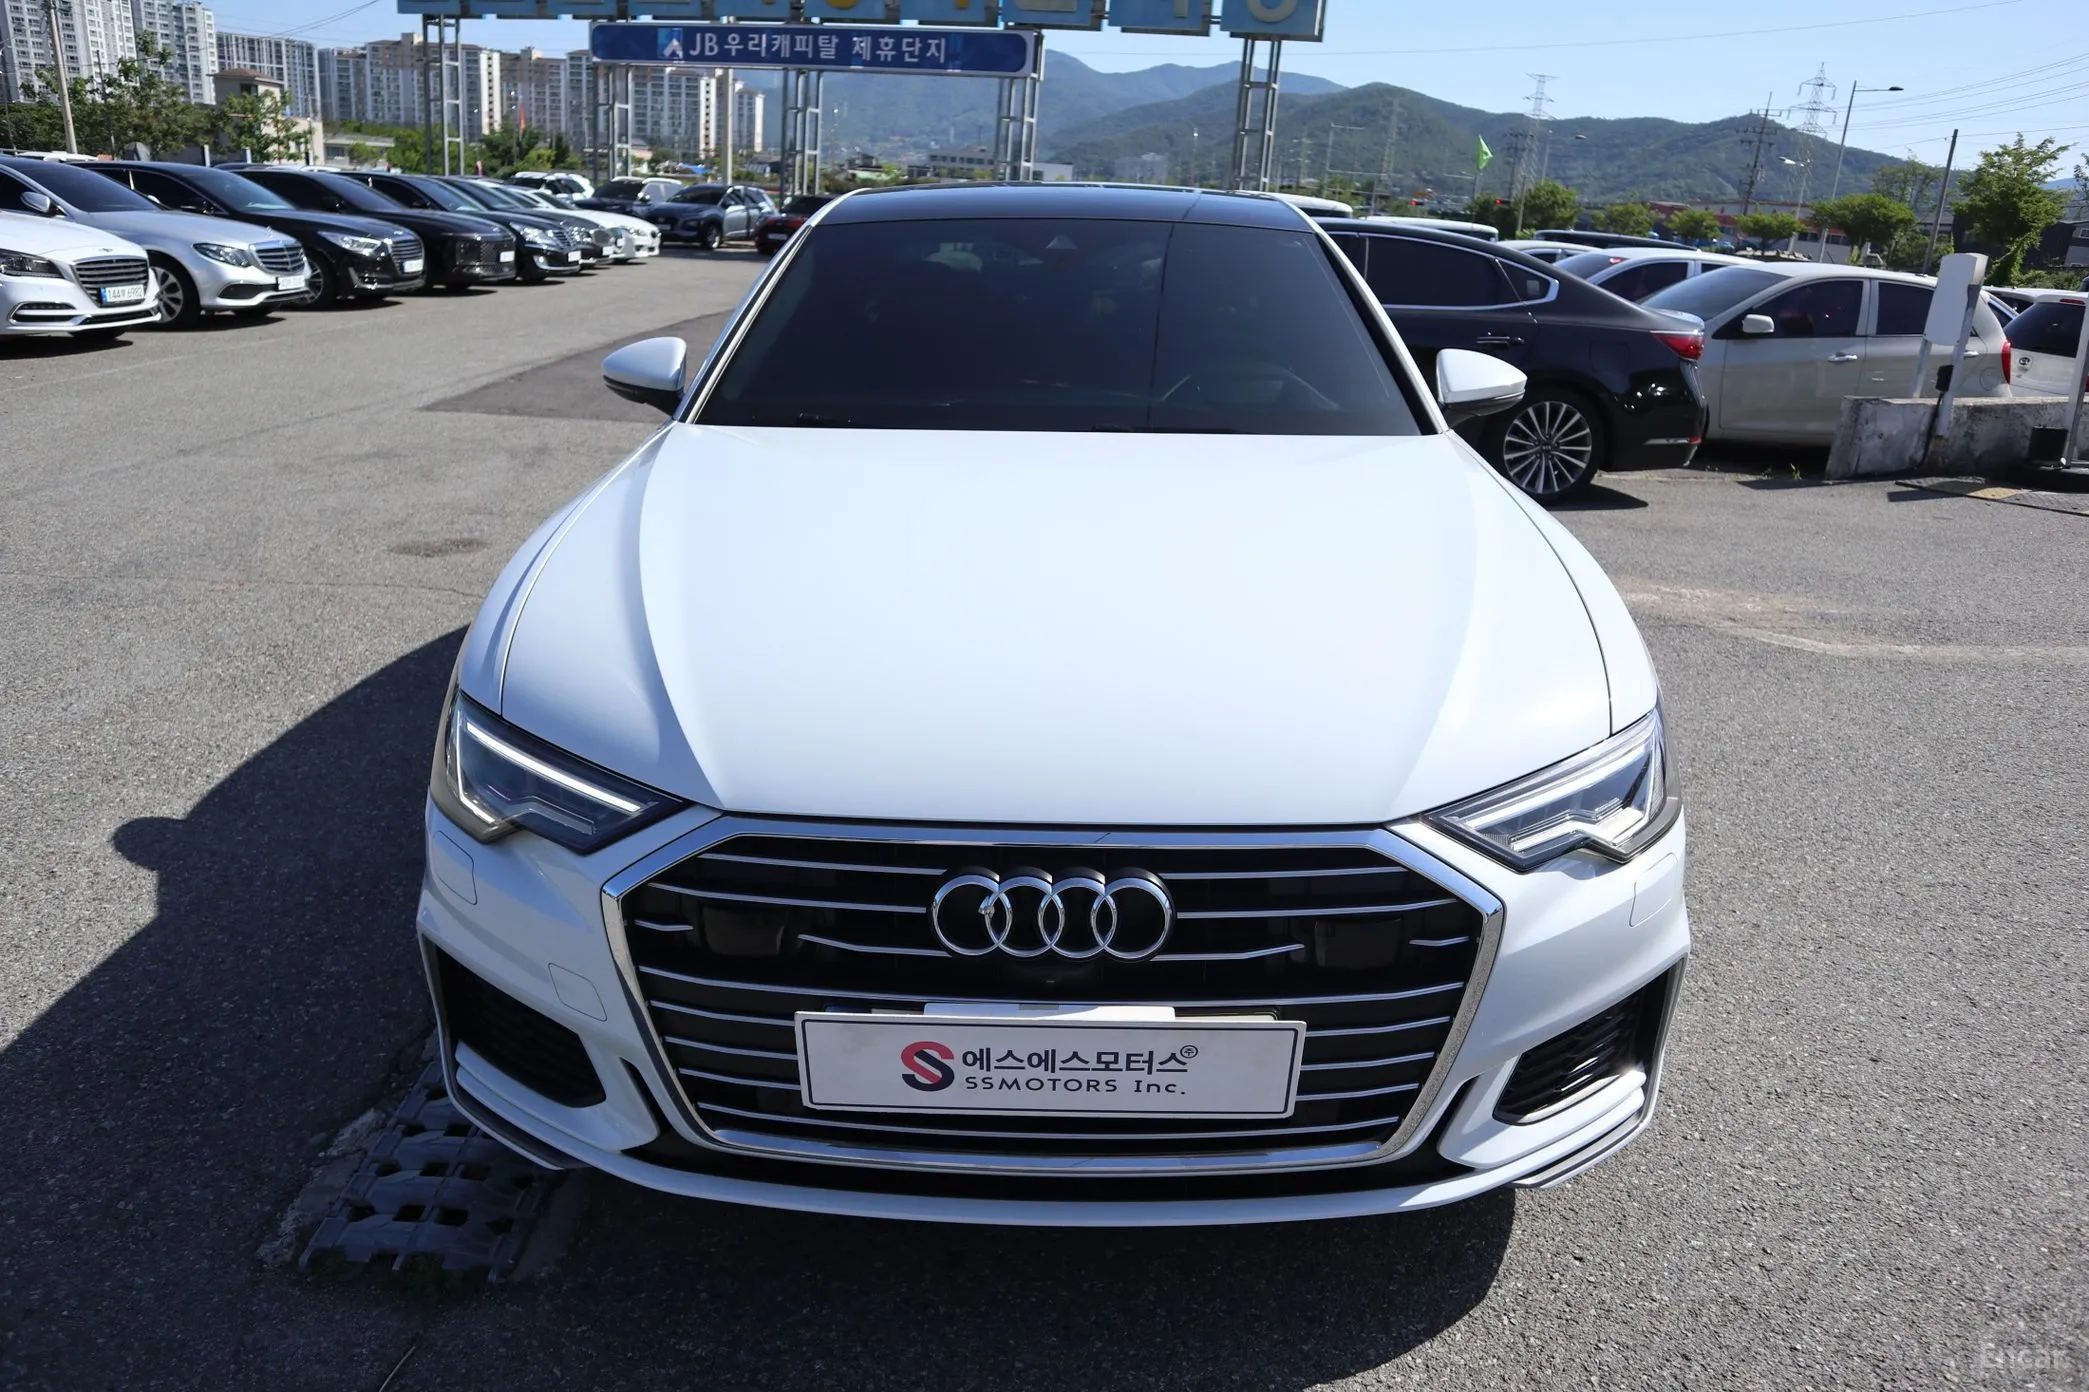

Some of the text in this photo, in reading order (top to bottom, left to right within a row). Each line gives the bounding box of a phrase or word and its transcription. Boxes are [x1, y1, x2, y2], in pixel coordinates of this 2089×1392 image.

[689, 32, 946, 63] JB우리캐피탈 제휴단지
[965, 1076, 1186, 1095] SSMOTORS Inc.
